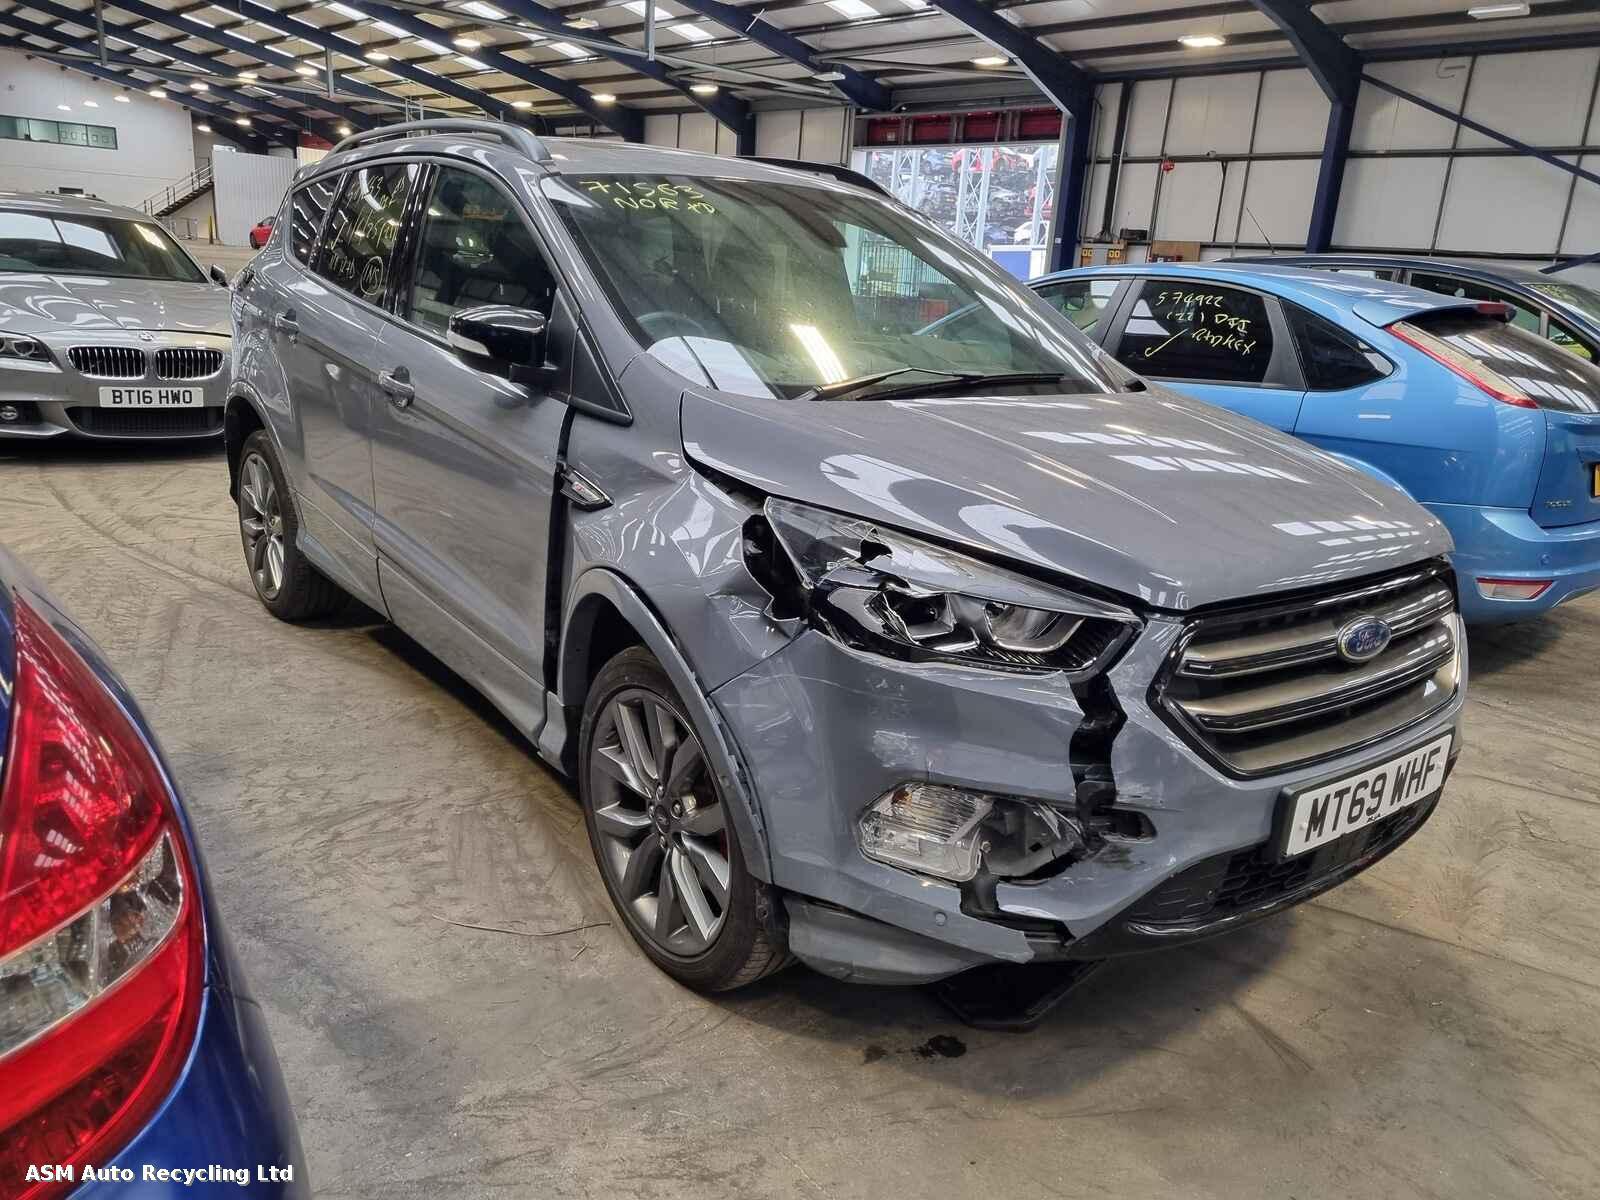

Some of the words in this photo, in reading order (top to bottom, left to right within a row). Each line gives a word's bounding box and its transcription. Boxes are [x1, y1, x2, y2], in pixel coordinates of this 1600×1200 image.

[111, 389, 153, 405] BT16
[158, 389, 193, 404] HWO
[1303, 771, 1388, 843] MT69
[1390, 746, 1441, 806] WHF
